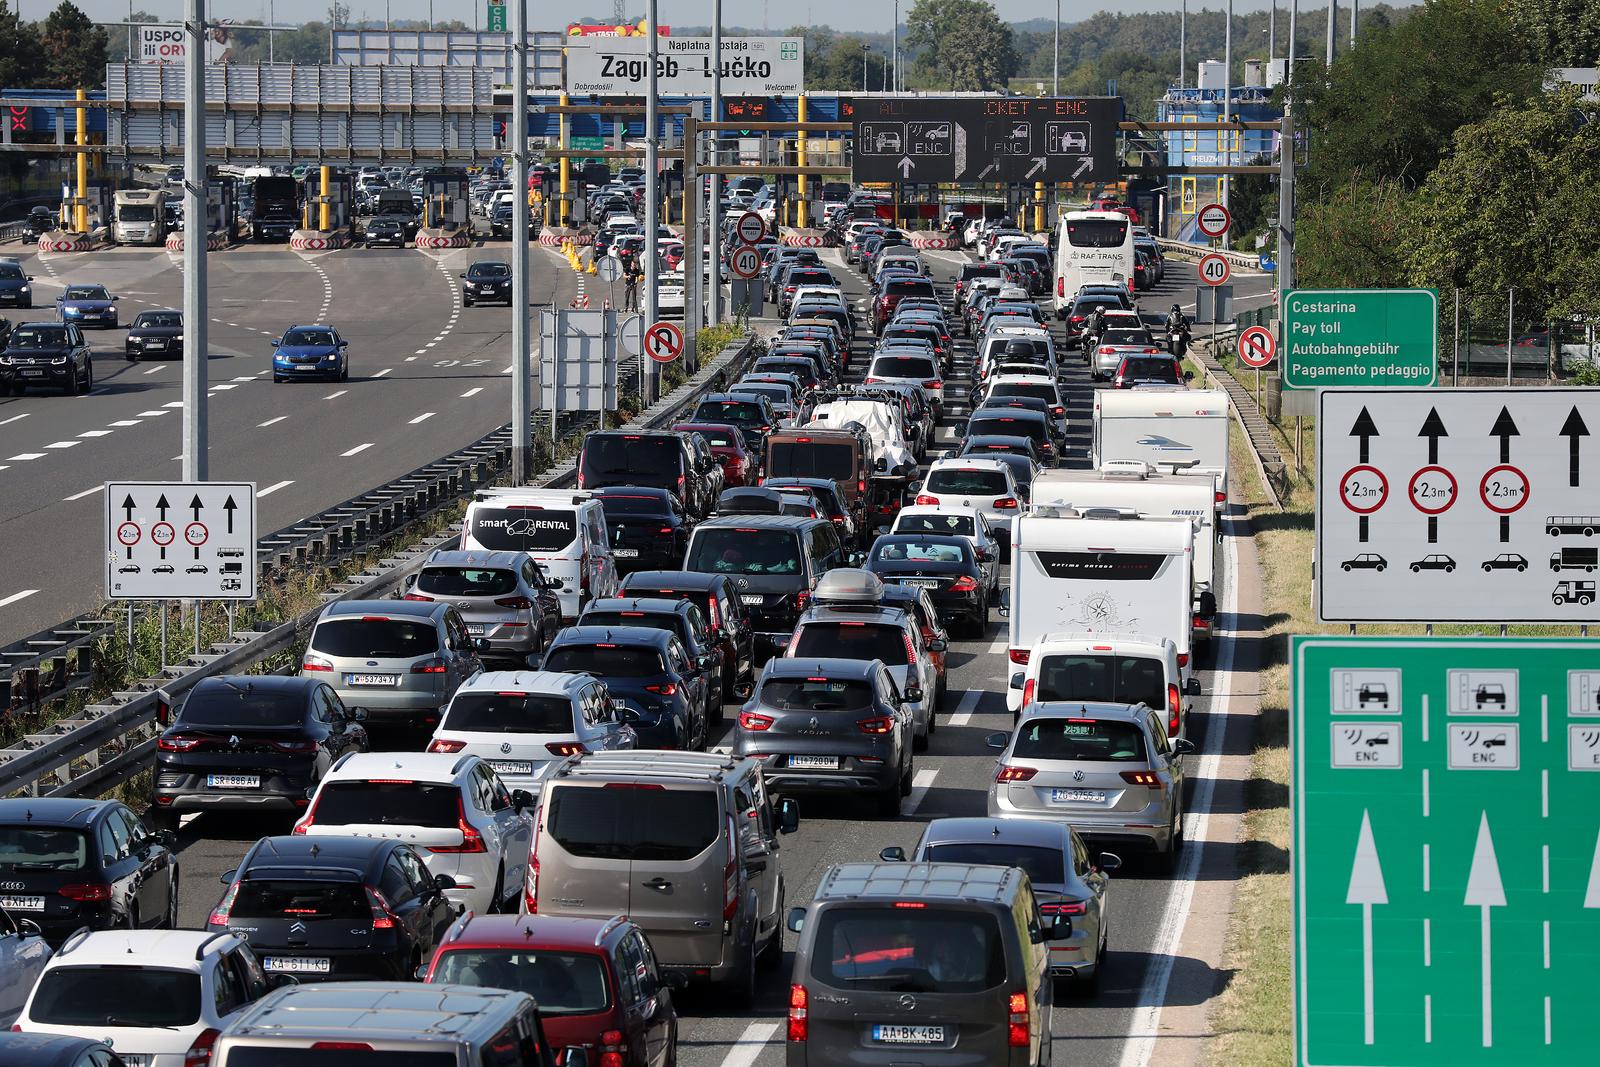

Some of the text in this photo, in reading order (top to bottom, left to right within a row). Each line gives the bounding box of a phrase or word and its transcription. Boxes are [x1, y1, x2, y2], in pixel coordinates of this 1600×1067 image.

[669, 40, 748, 51] Naplatna ostaja
[764, 84, 797, 92] Welcome!
[1055, 101, 1087, 115] ENC
[915, 142, 943, 154] ENC
[739, 254, 756, 270] 40
[1205, 262, 1224, 278] 40
[1291, 301, 1356, 313] Cestarina
[1291, 322, 1341, 336] Pay toll
[1291, 343, 1400, 357] Autobahngebühr
[1291, 363, 1430, 378] Pagamento pedaggio
[479, 518, 570, 531] smart RENTAL
[1355, 752, 1379, 762] ENC
[1472, 753, 1496, 763] ENC
[271, 958, 284, 970] KA
[882, 1028, 897, 1040] AA
